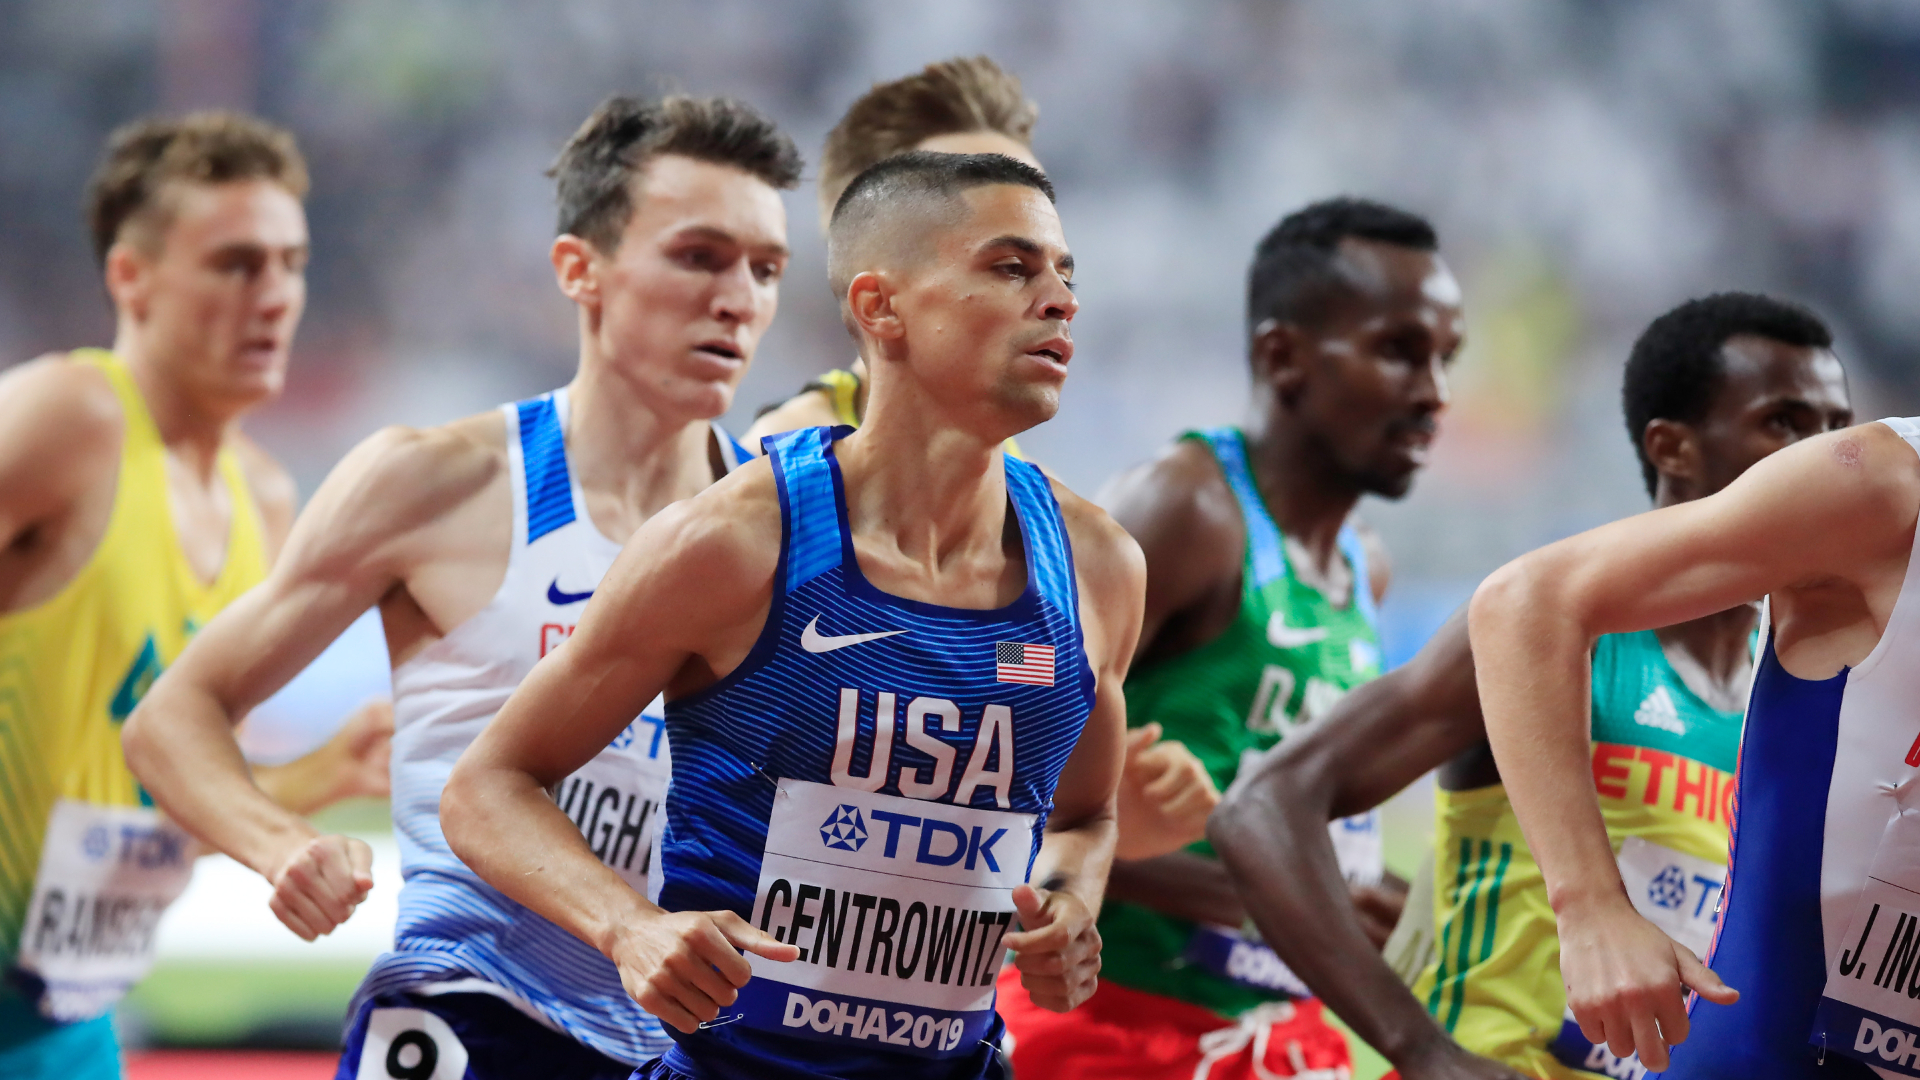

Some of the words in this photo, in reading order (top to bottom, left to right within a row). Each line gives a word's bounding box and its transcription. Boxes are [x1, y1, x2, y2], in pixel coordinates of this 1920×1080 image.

[830, 687, 1014, 808] USA
[870, 810, 1008, 873] TDK
[760, 878, 1012, 987] CENTROWITZ
[1839, 903, 1880, 977] J.
[1873, 912, 1920, 999] IN
[782, 991, 964, 1051] DOHA2019
